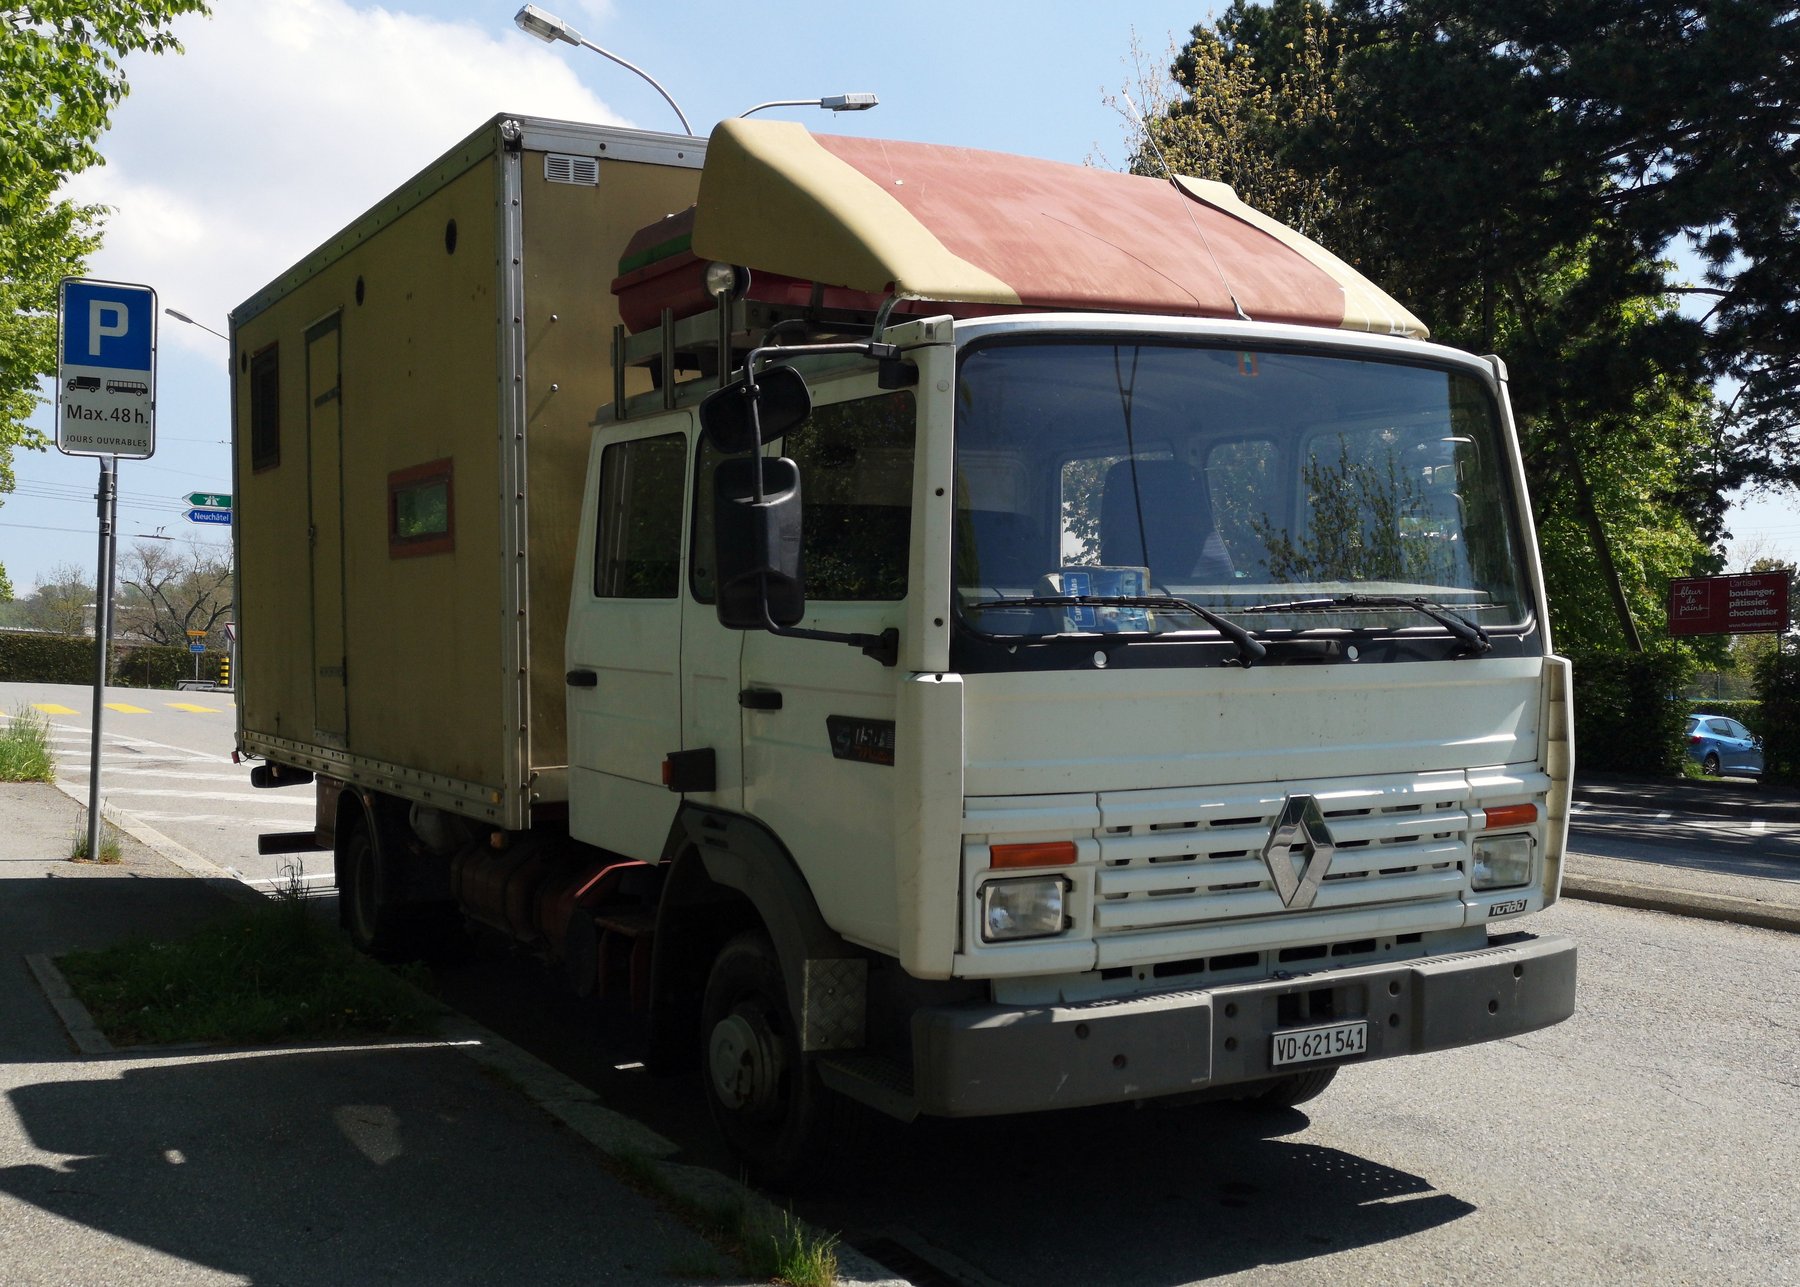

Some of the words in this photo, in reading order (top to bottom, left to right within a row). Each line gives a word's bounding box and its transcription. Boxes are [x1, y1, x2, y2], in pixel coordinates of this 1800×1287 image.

[89, 299, 129, 356] P
[67, 404, 108, 421] Max.
[66, 434, 93, 444] JOURS
[96, 436, 147, 447] OUVRABLES
[194, 512, 229, 521] Neuchâtel
[1729, 589, 1775, 597] boulanger,
[1729, 598, 1769, 609] pâtissier,
[1729, 607, 1778, 617] chocolatier
[1491, 900, 1525, 916] TURBO
